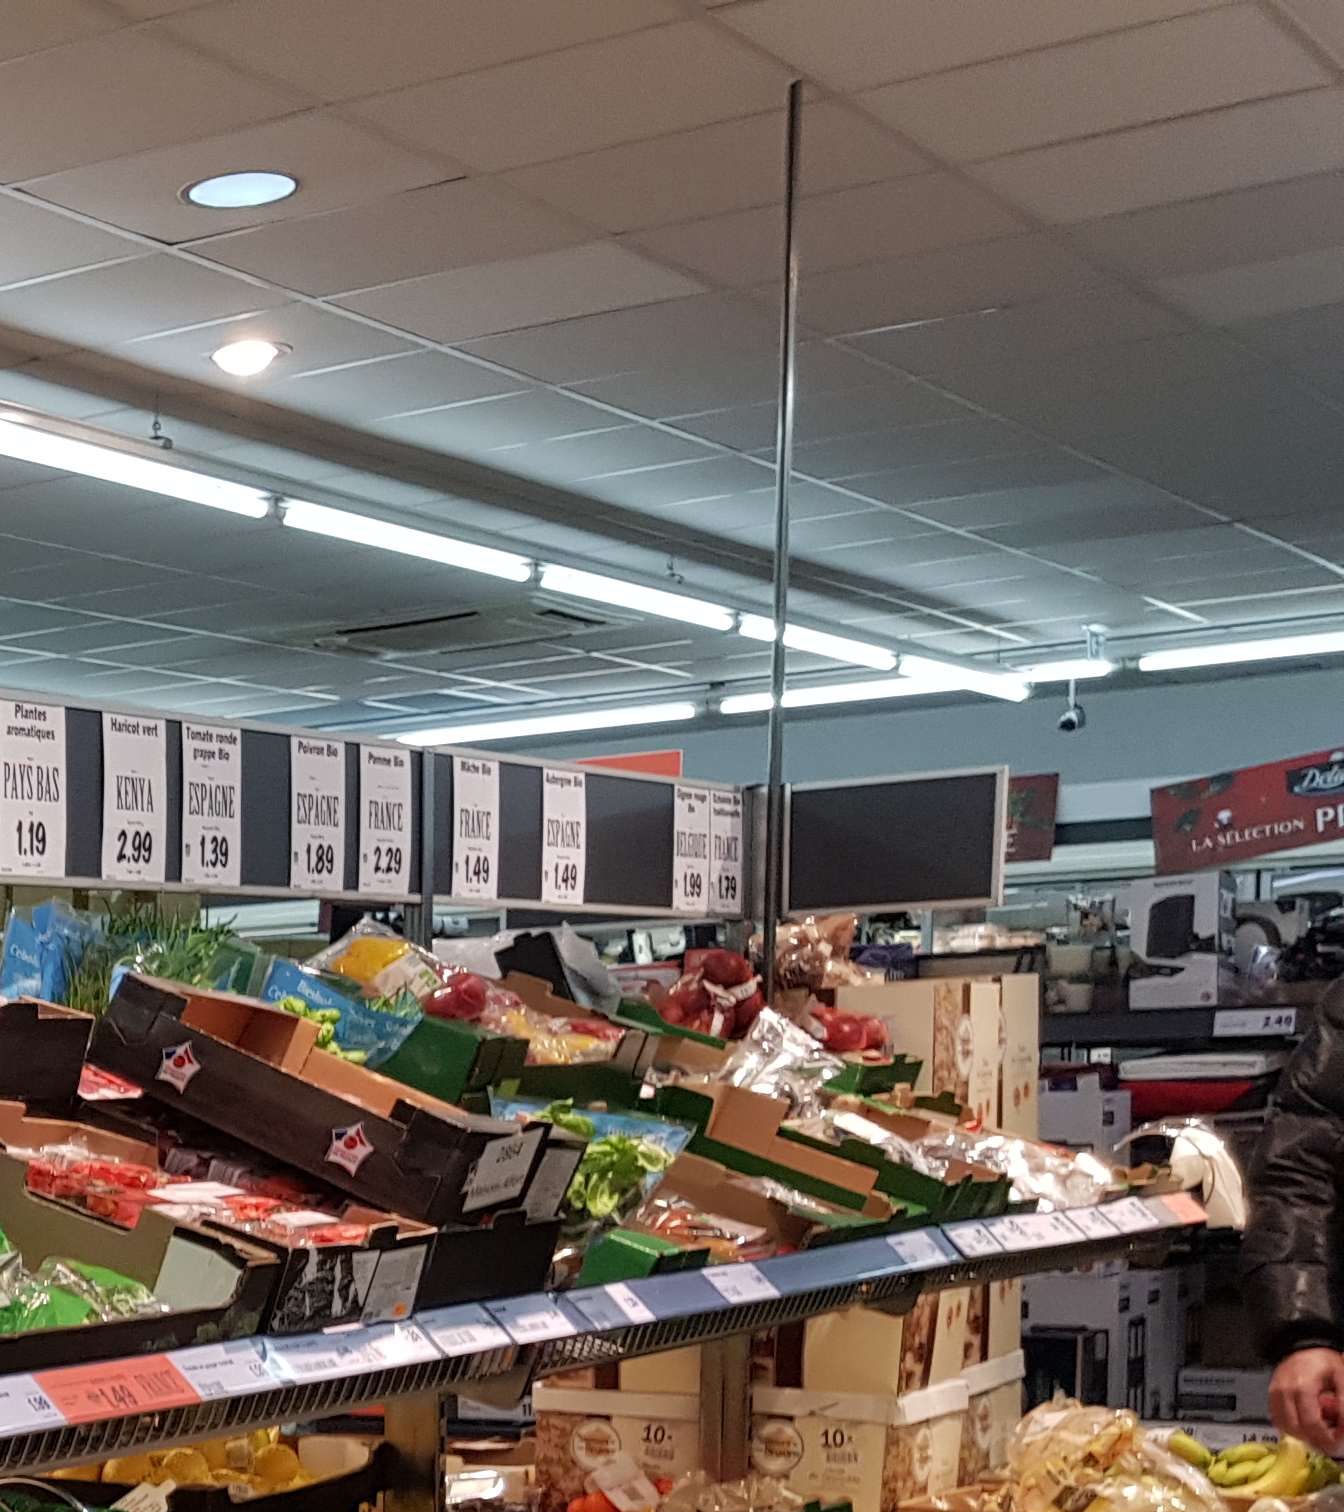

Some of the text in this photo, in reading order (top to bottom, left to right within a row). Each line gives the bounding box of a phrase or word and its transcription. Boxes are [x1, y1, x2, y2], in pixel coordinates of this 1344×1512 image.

[14, 703, 47, 721] Plantes
[111, 717, 158, 739] Haricot vert
[6, 724, 56, 742] aromatiques
[186, 725, 214, 742] Tomate
[3, 761, 60, 802] PAYS BAS
[116, 774, 154, 814] KENYA
[188, 781, 235, 819] ESPAGNE
[297, 792, 339, 829] ESPAGNE
[368, 800, 403, 832] FRANCE
[16, 819, 47, 857] 1.19
[460, 808, 491, 841] FRANCE
[547, 818, 581, 850] ESPAGNE
[116, 828, 153, 865] 2.99
[200, 834, 229, 869] 1.39
[306, 843, 334, 875] 1.89
[373, 846, 402, 875] 2.29
[465, 855, 490, 885] 1.49
[554, 863, 577, 891] 1.49
[683, 872, 702, 898] 1.99
[718, 875, 737, 900] 1.79
